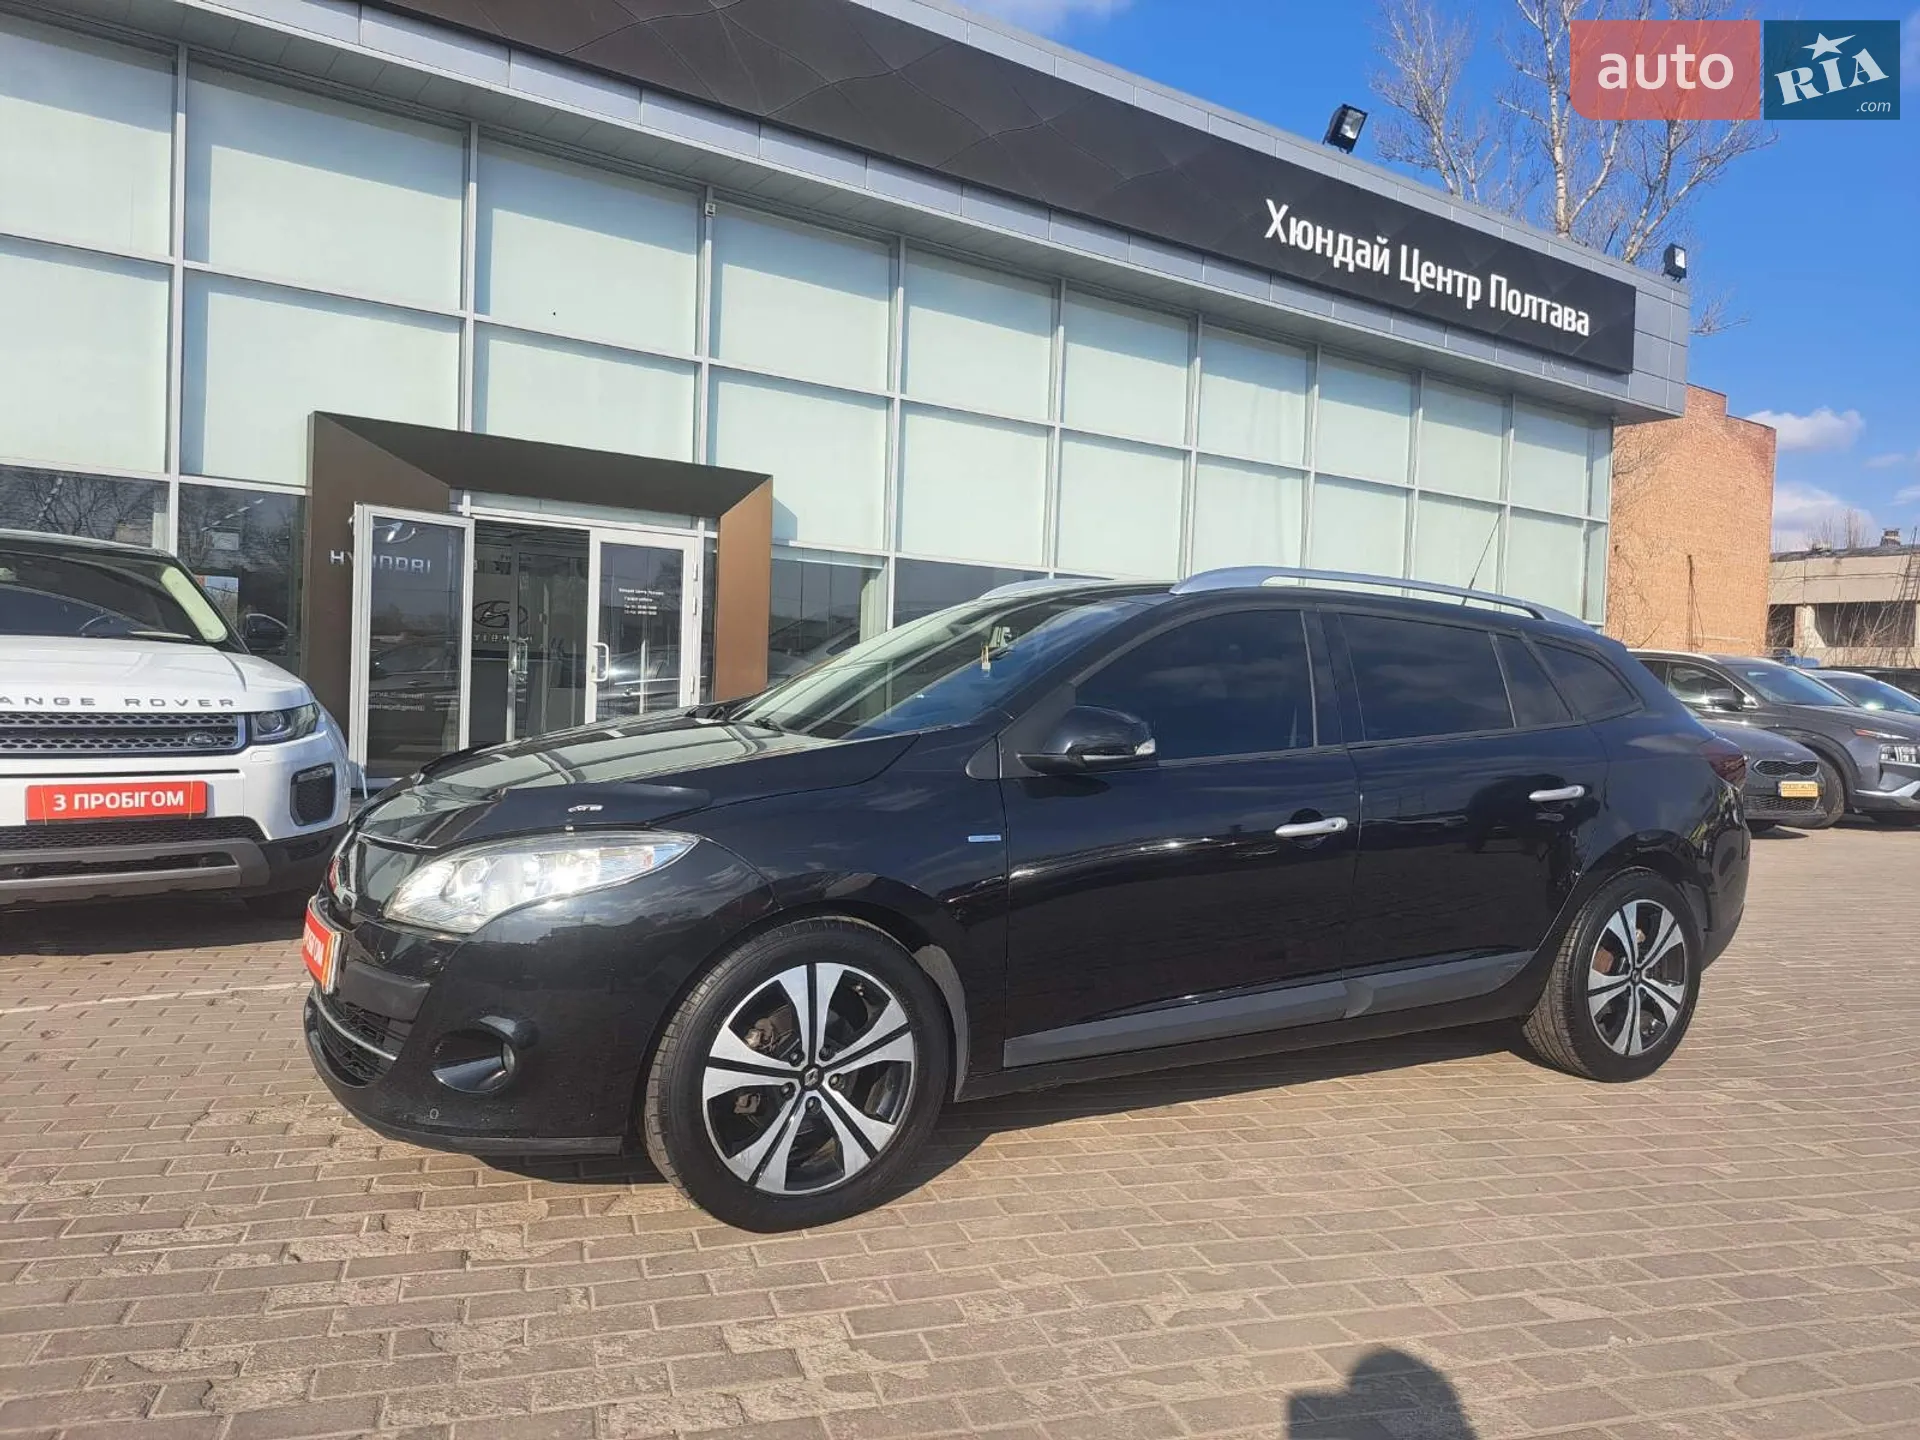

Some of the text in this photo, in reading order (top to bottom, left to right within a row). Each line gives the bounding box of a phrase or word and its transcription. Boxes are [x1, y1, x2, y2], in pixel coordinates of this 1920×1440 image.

[1264, 198, 1590, 337] Хюндай Центр Полтава
[329, 549, 431, 573] HNDAI
[124, 697, 235, 708] ROVER
[73, 789, 184, 811] ПРОБІГОМ
